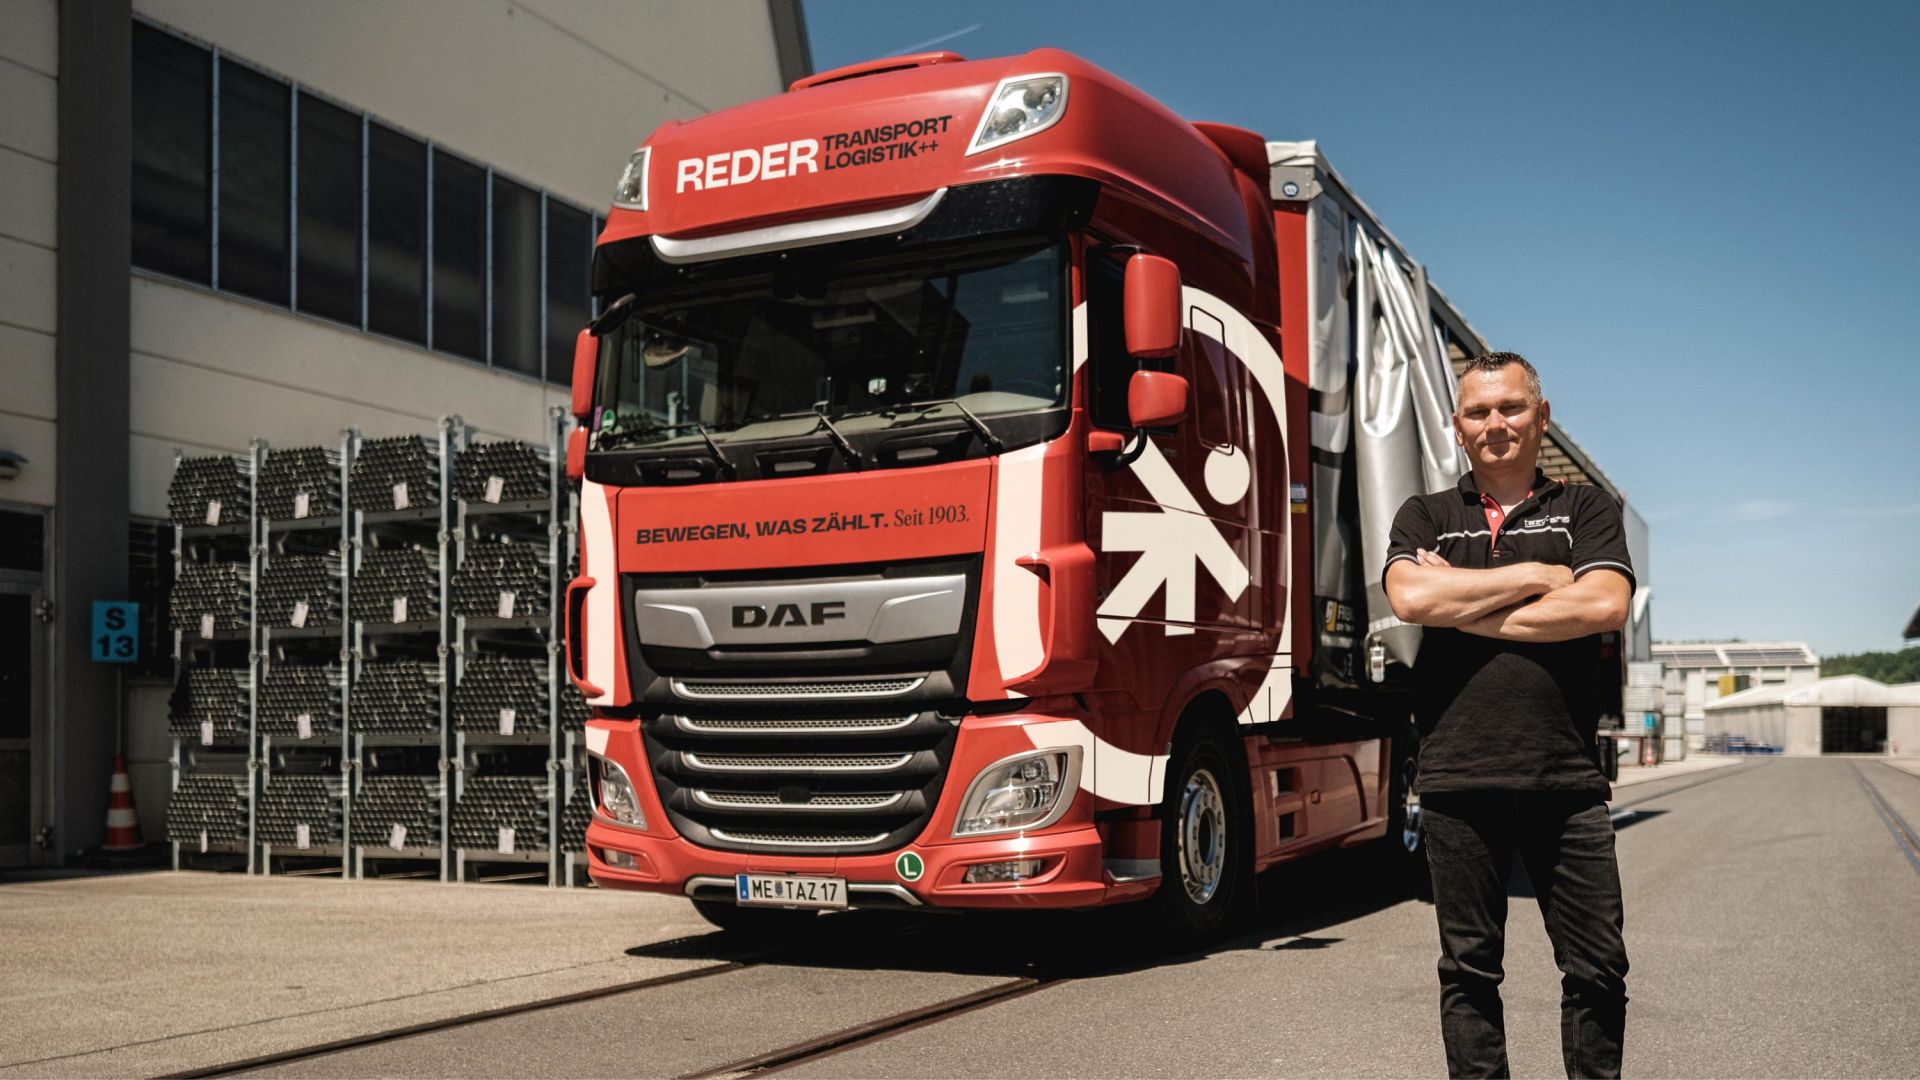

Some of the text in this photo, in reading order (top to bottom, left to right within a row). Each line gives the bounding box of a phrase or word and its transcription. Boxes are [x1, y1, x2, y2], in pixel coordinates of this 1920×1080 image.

[822, 115, 952, 151] TRANSPORT
[676, 138, 820, 194] REDER
[824, 140, 939, 171] LOGISTIK++
[636, 504, 971, 545] BEWEGEN, WAS ZÄHLT. Seit 1903.
[105, 607, 126, 631] S
[732, 601, 846, 628] DAF
[97, 635, 134, 657] 13
[904, 857, 917, 876] L
[752, 879, 773, 899] ME
